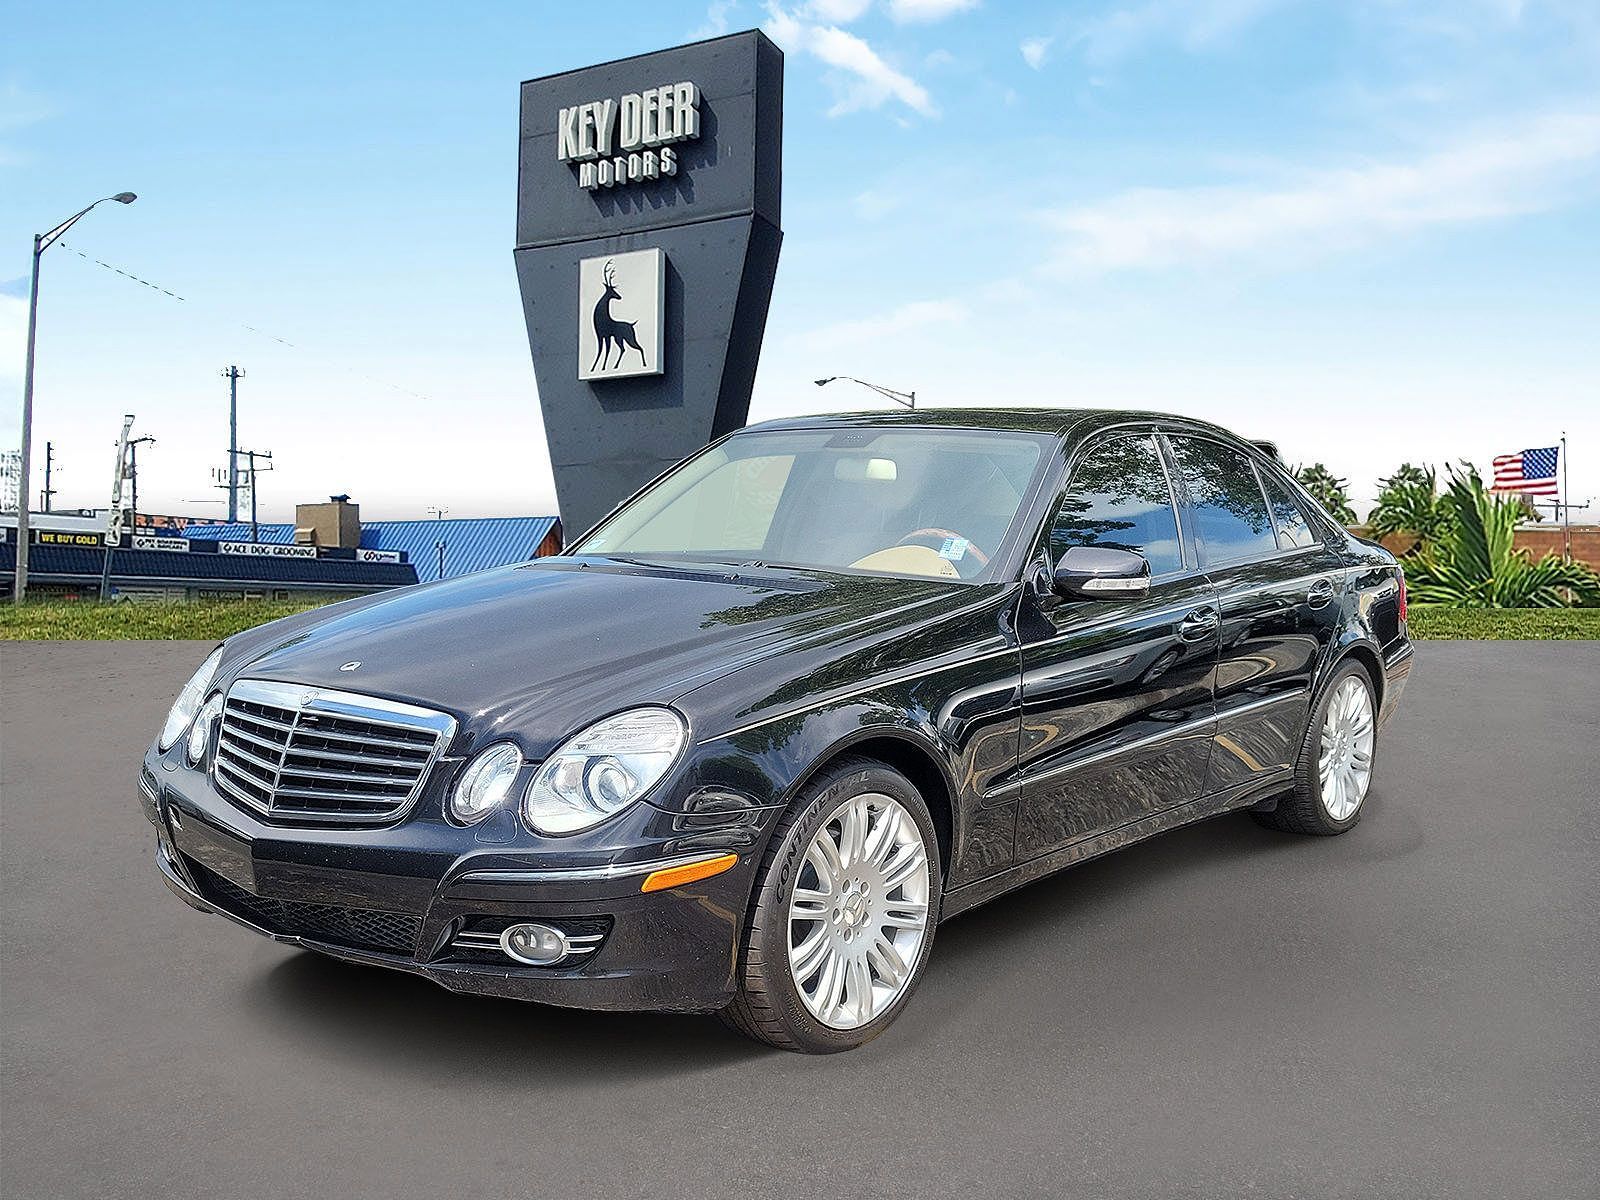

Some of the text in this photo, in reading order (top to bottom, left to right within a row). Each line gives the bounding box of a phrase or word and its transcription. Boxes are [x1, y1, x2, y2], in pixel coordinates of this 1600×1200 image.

[557, 81, 701, 163] KEY DEER
[579, 147, 677, 190] MOTORS
[41, 533, 98, 545] WE BUY GOLD
[232, 544, 316, 557] ACE DOG GROOMING
